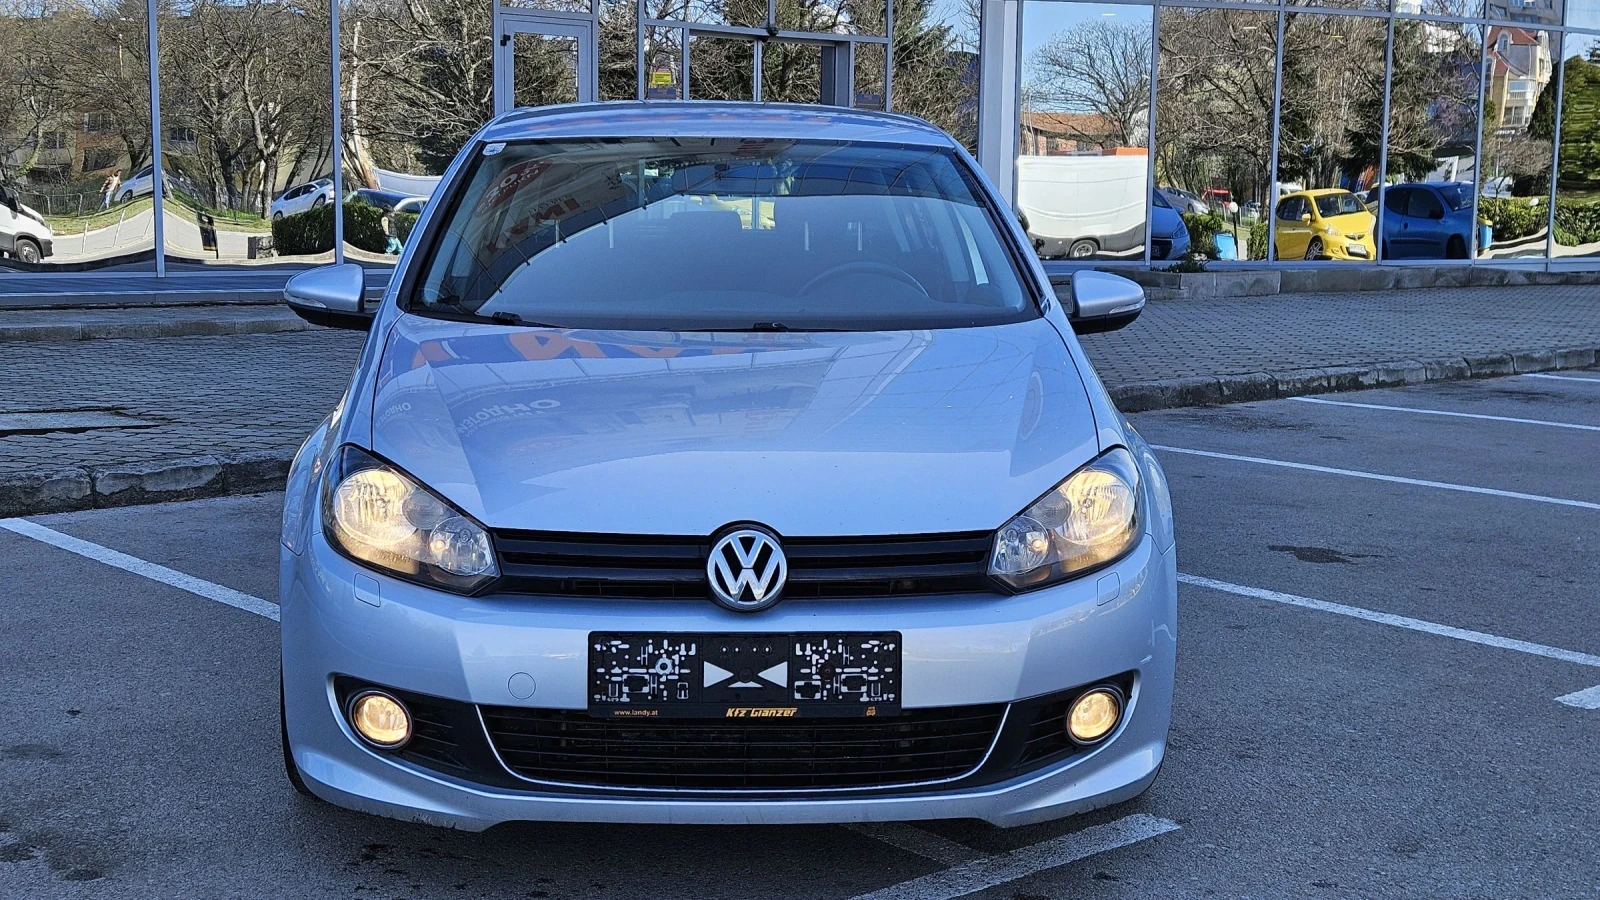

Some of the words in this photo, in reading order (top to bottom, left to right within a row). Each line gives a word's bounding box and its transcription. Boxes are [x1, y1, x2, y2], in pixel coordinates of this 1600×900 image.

[613, 709, 659, 717] www.landy.at
[726, 707, 748, 717] Kfz
[750, 707, 798, 717] Glanzer
